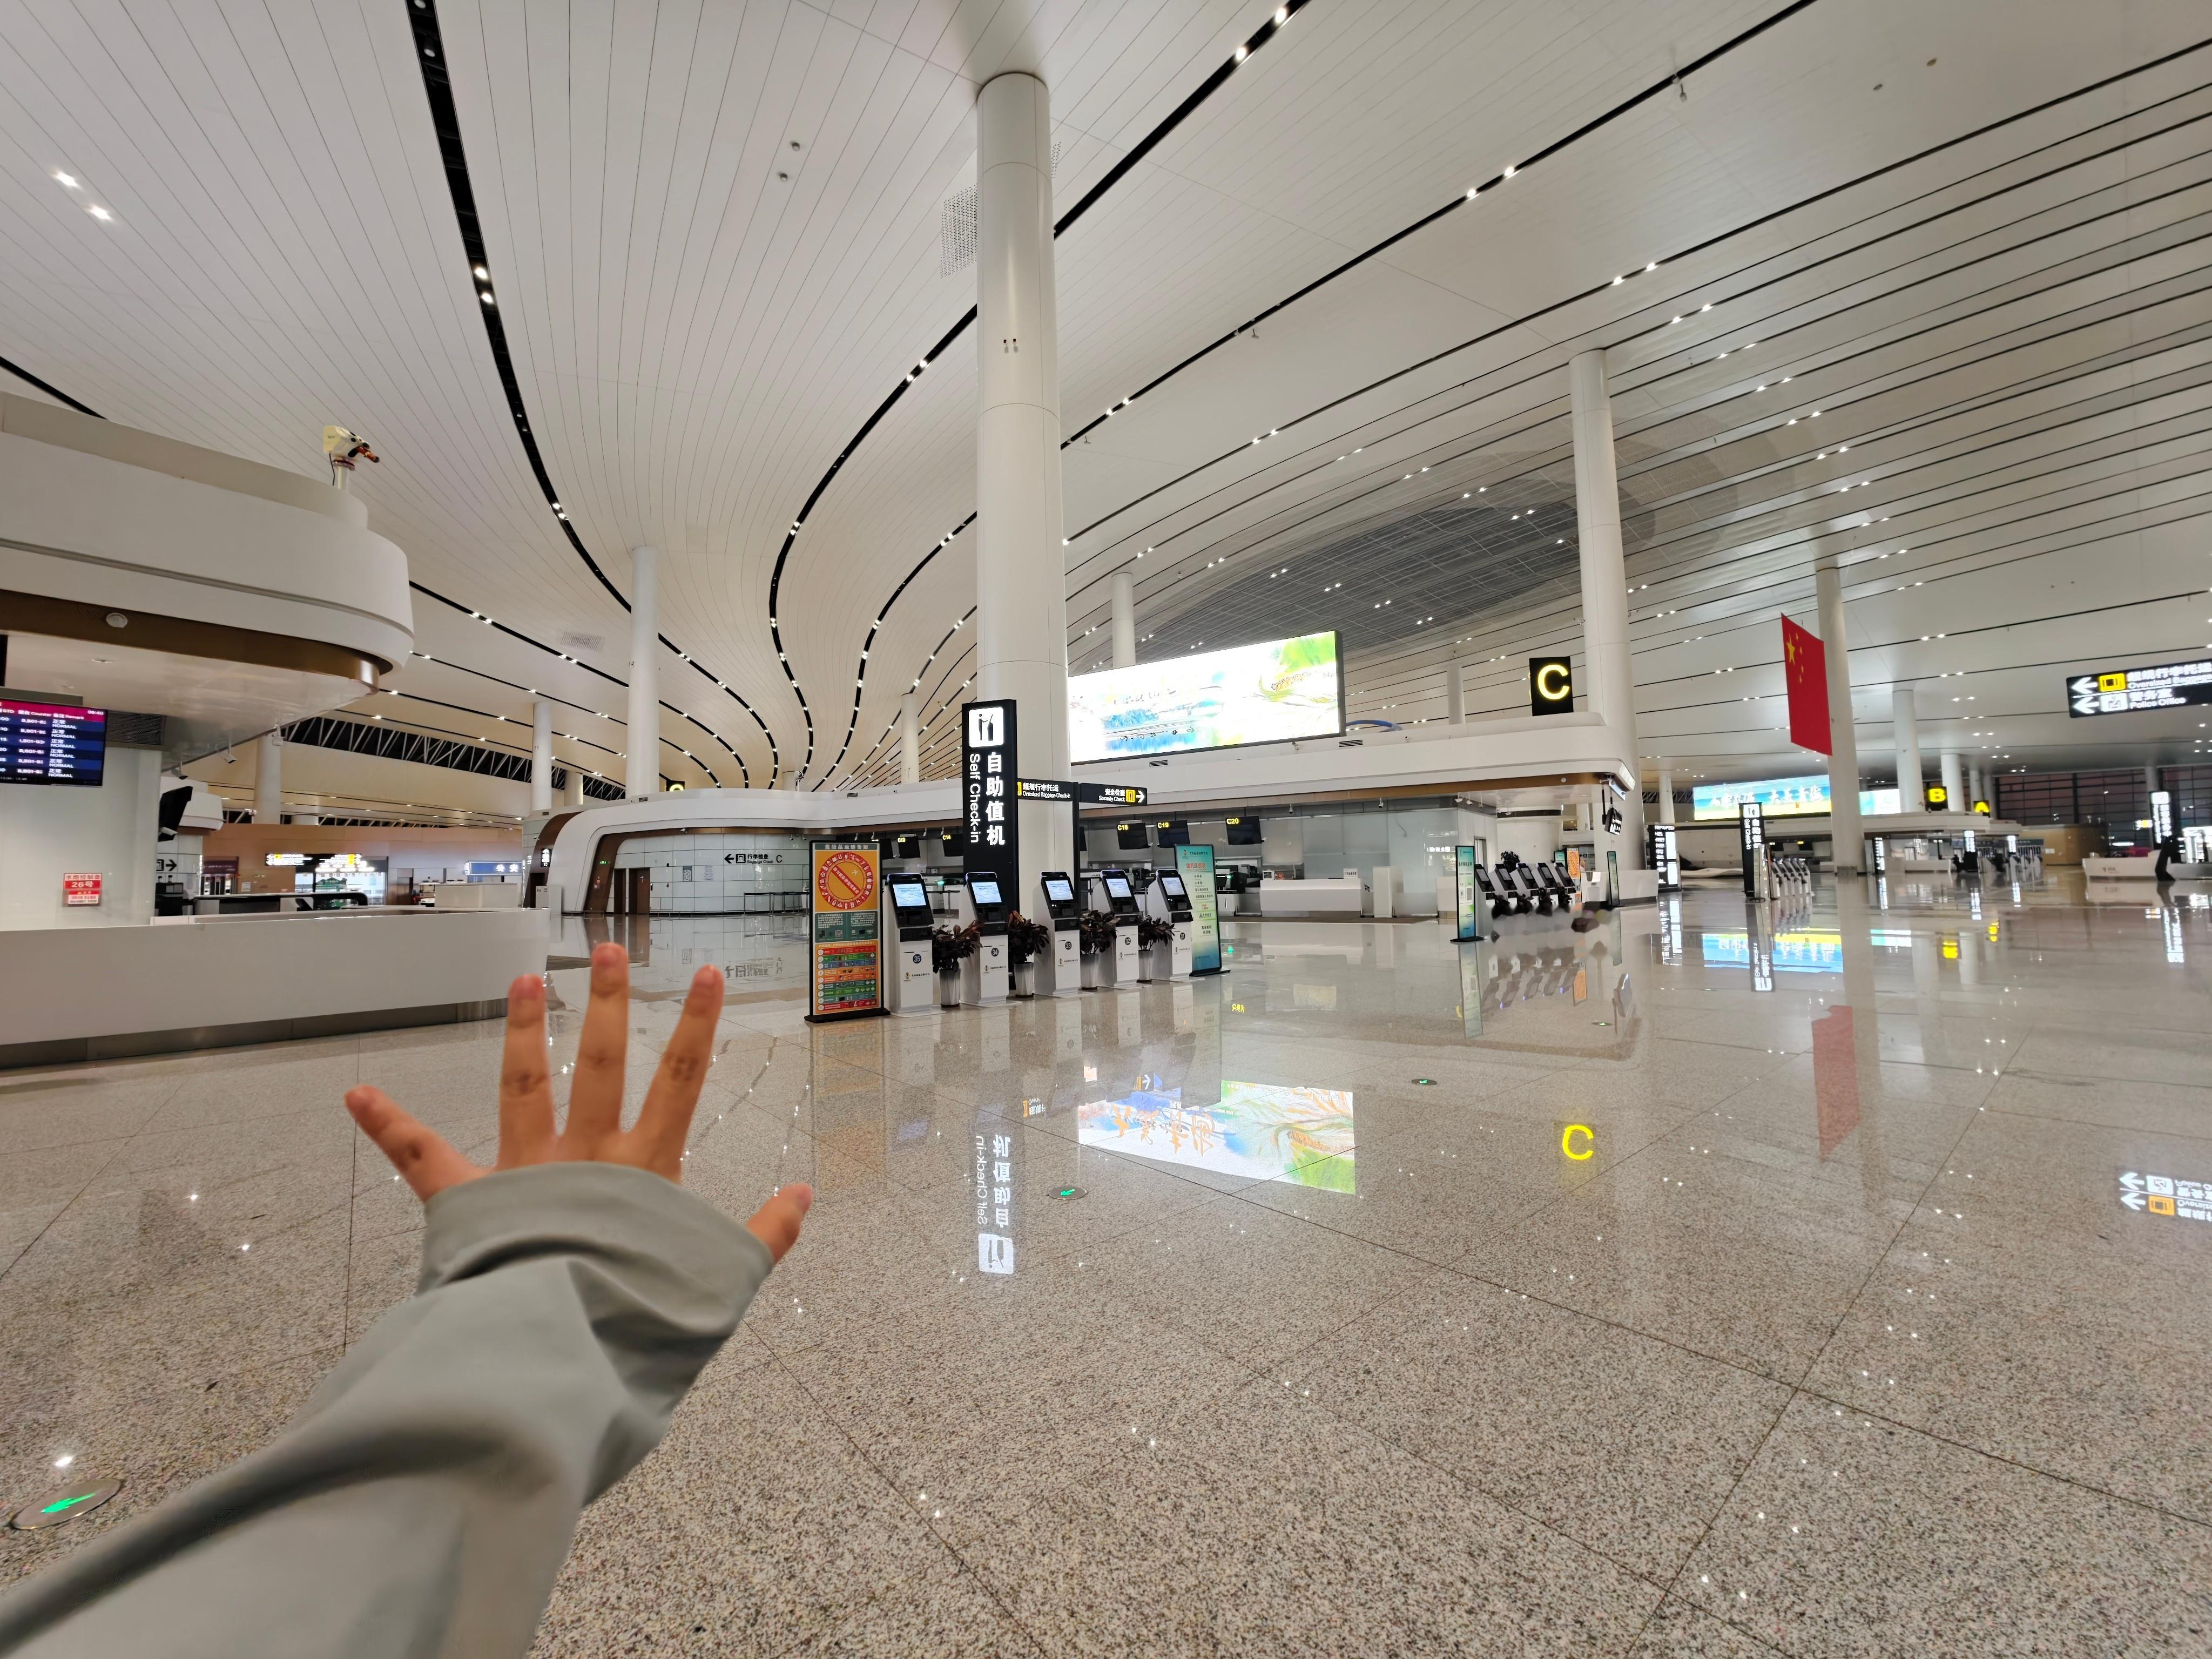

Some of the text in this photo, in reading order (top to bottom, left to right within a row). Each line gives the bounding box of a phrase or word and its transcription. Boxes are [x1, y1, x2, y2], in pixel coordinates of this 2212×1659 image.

[1537, 664, 1570, 699] C
[2129, 697, 2187, 709] Police Office
[969, 753, 981, 843] Self Check-in
[986, 752, 1005, 846] 自助值机
[1104, 788, 1125, 797] 安全检查
[1928, 788, 1946, 802] B
[1974, 801, 1990, 813] A
[776, 855, 783, 863] C
